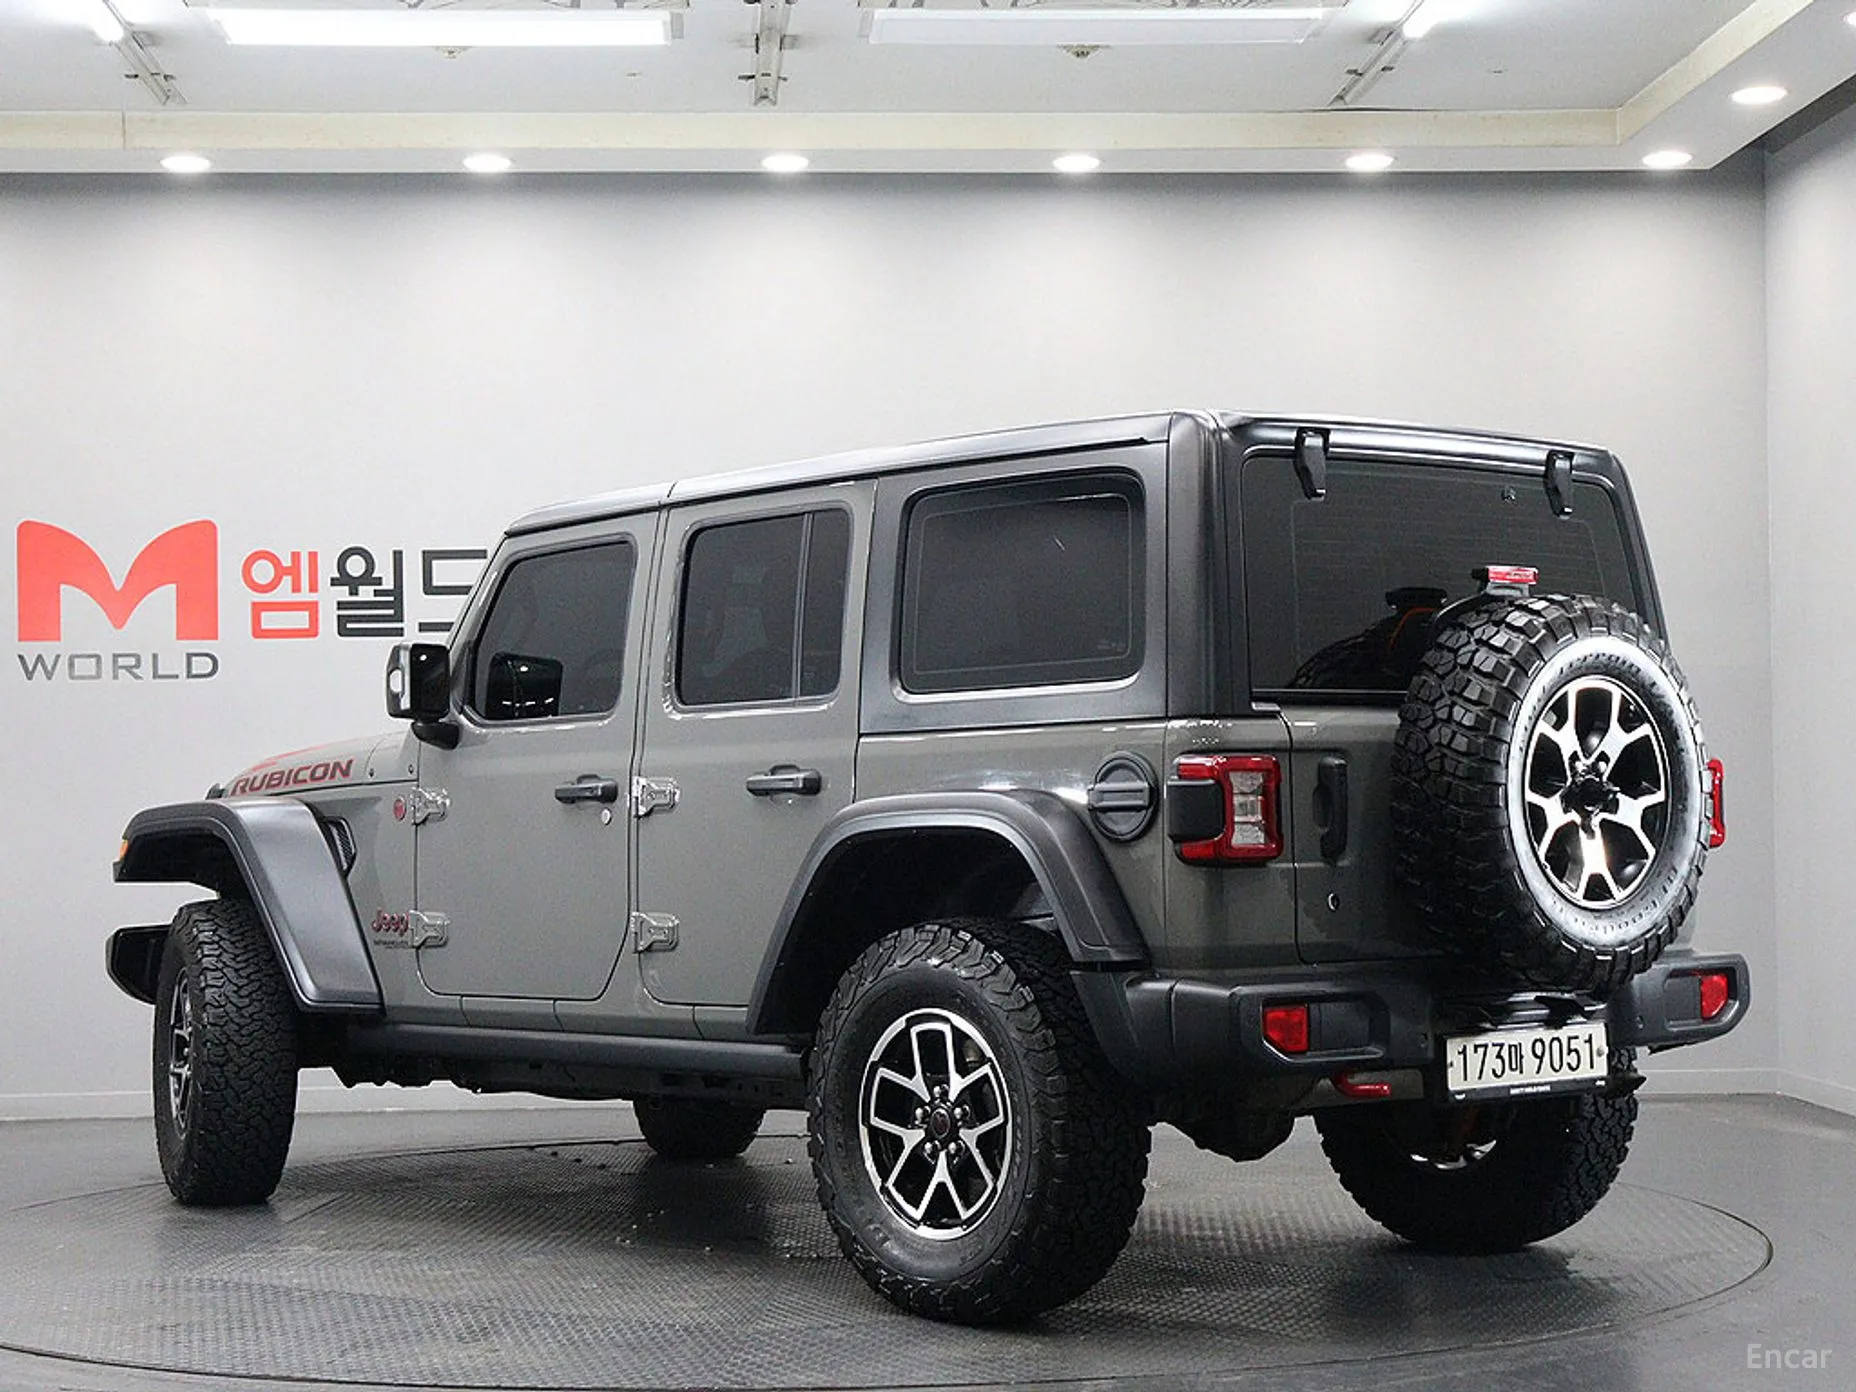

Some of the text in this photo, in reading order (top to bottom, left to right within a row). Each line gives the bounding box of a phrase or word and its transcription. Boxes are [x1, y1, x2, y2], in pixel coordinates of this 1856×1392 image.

[241, 546, 488, 638] 엠월드
[18, 653, 219, 681] WORLD
[229, 757, 355, 797] RUBICON
[372, 909, 410, 936] Jeep
[1457, 1033, 1595, 1082] 173마 9051
